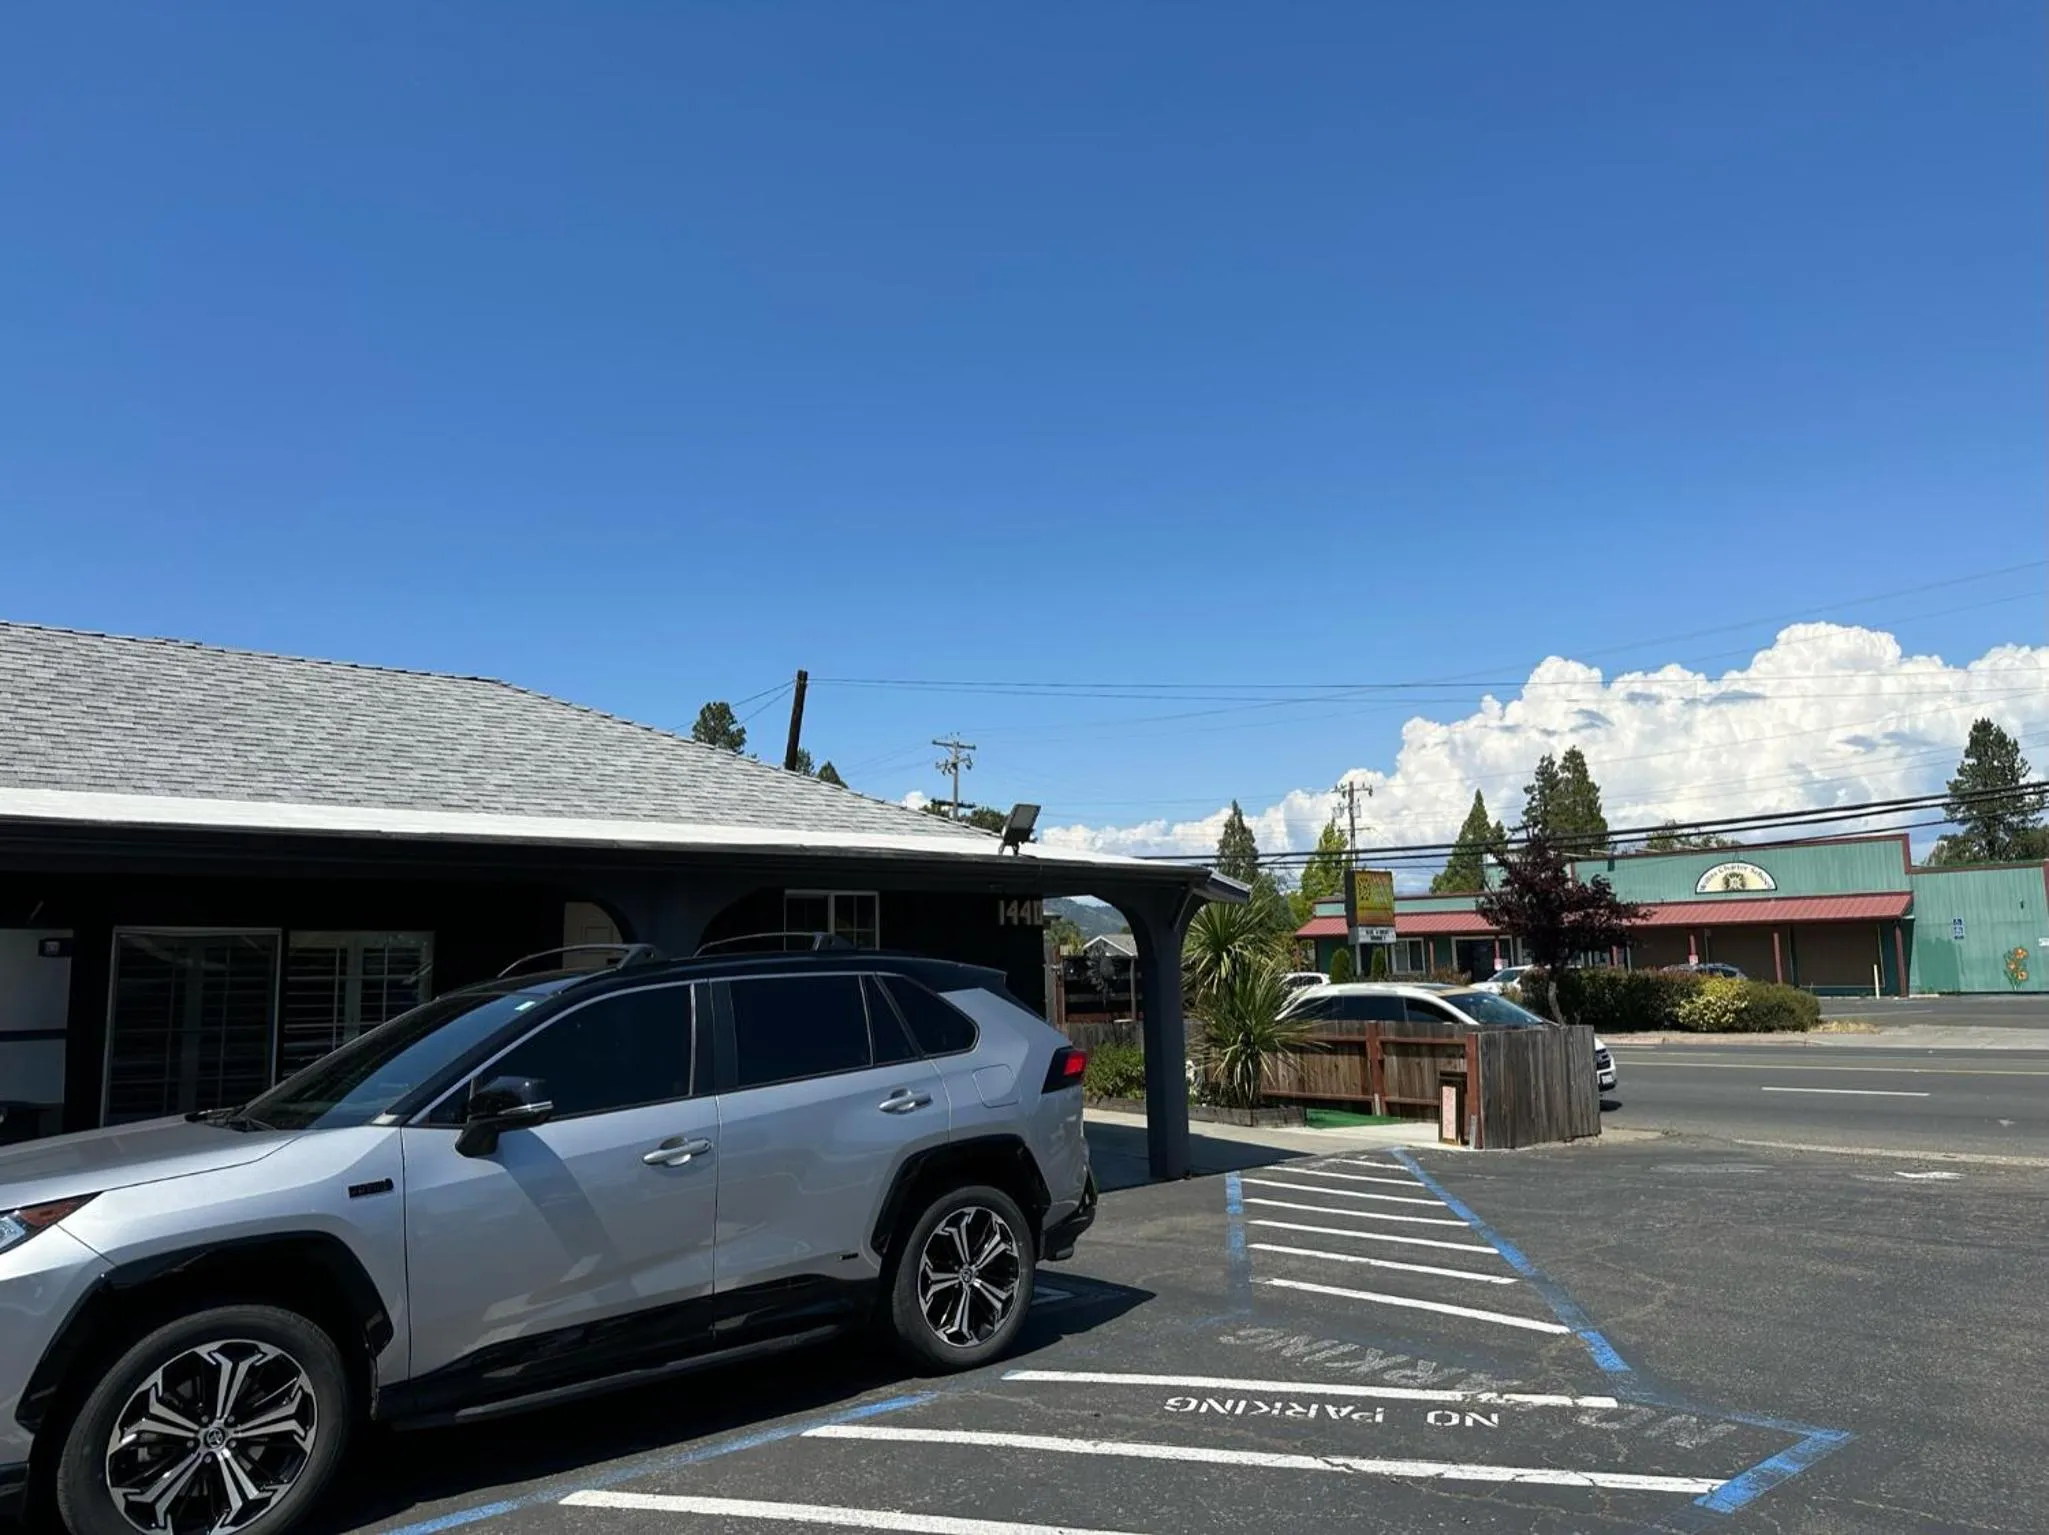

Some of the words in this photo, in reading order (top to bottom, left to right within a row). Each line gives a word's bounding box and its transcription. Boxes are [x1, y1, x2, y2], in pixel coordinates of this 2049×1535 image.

[1218, 1327, 1522, 1400] ARKING
[1163, 1397, 1385, 1424] PARKING
[1427, 1410, 1499, 1428] NO
